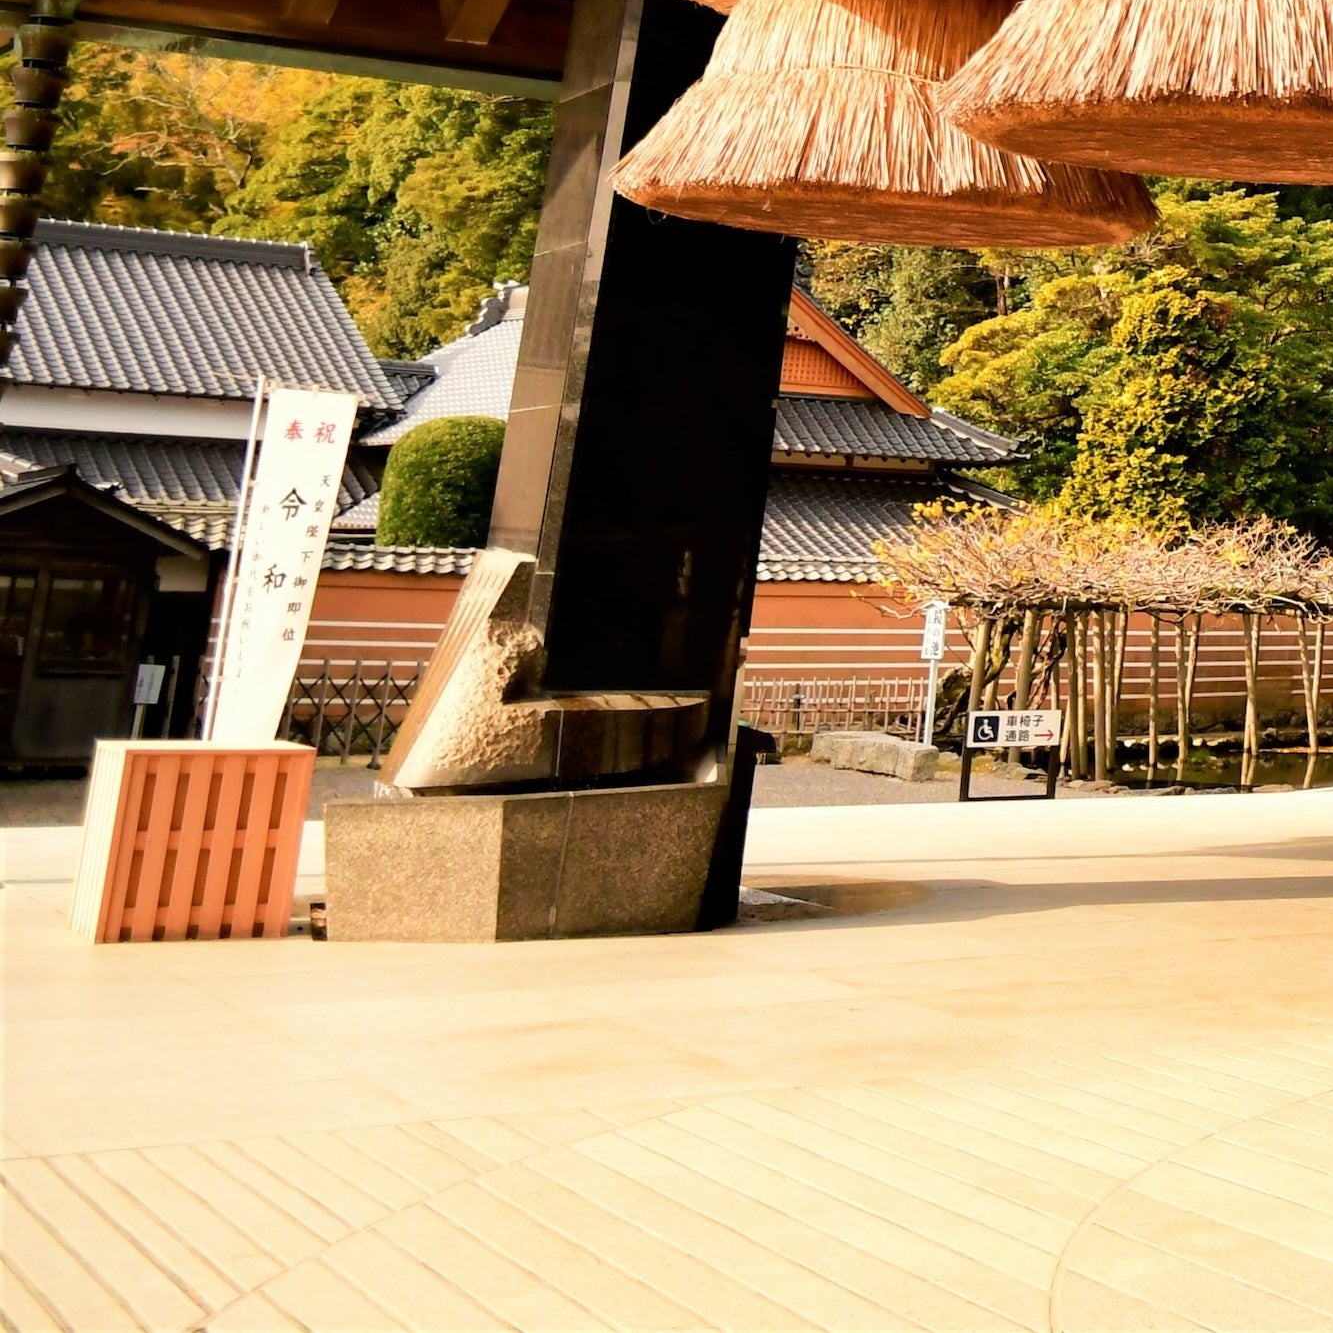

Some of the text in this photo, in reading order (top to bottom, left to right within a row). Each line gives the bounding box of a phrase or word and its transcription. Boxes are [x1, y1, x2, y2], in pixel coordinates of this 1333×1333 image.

[284, 419, 337, 444] 奉祝
[261, 487, 308, 594] 令和
[281, 474, 333, 642] 天皇陛下御即位
[1006, 714, 1044, 727] 車椅子
[1004, 729, 1030, 742] 通路
